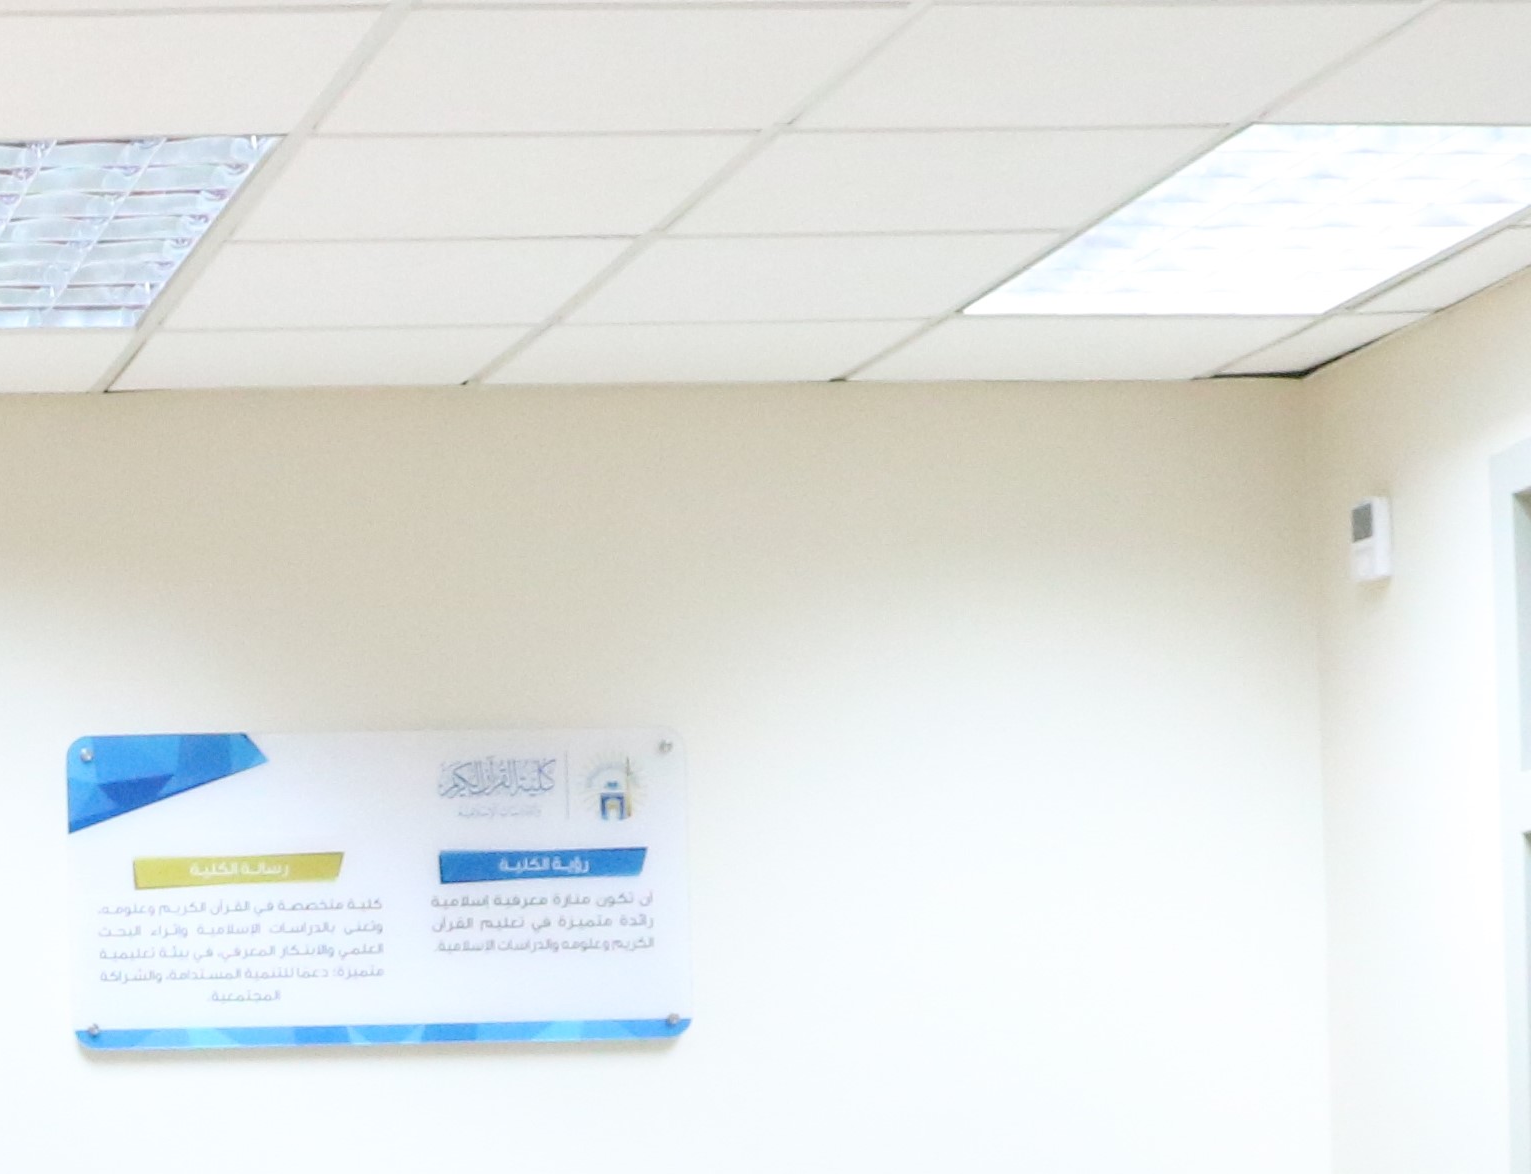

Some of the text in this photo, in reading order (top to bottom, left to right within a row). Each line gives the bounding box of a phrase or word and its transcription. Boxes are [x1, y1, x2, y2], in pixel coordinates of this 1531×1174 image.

[189, 861, 289, 877] رسالة الكلية
[499, 856, 589, 874] رؤية الكلية
[277, 898, 344, 912] متخصصة
[347, 898, 383, 911] كلية
[493, 895, 548, 909] معرفية
[552, 893, 591, 908] منارة
[596, 891, 634, 908] تكون
[158, 901, 207, 916] الكريم
[253, 902, 275, 917] في
[480, 916, 525, 931] تعليم
[531, 917, 552, 933] في
[611, 936, 654, 952] الكريم
[99, 947, 155, 962] تعليمية
[193, 945, 214, 963] في
